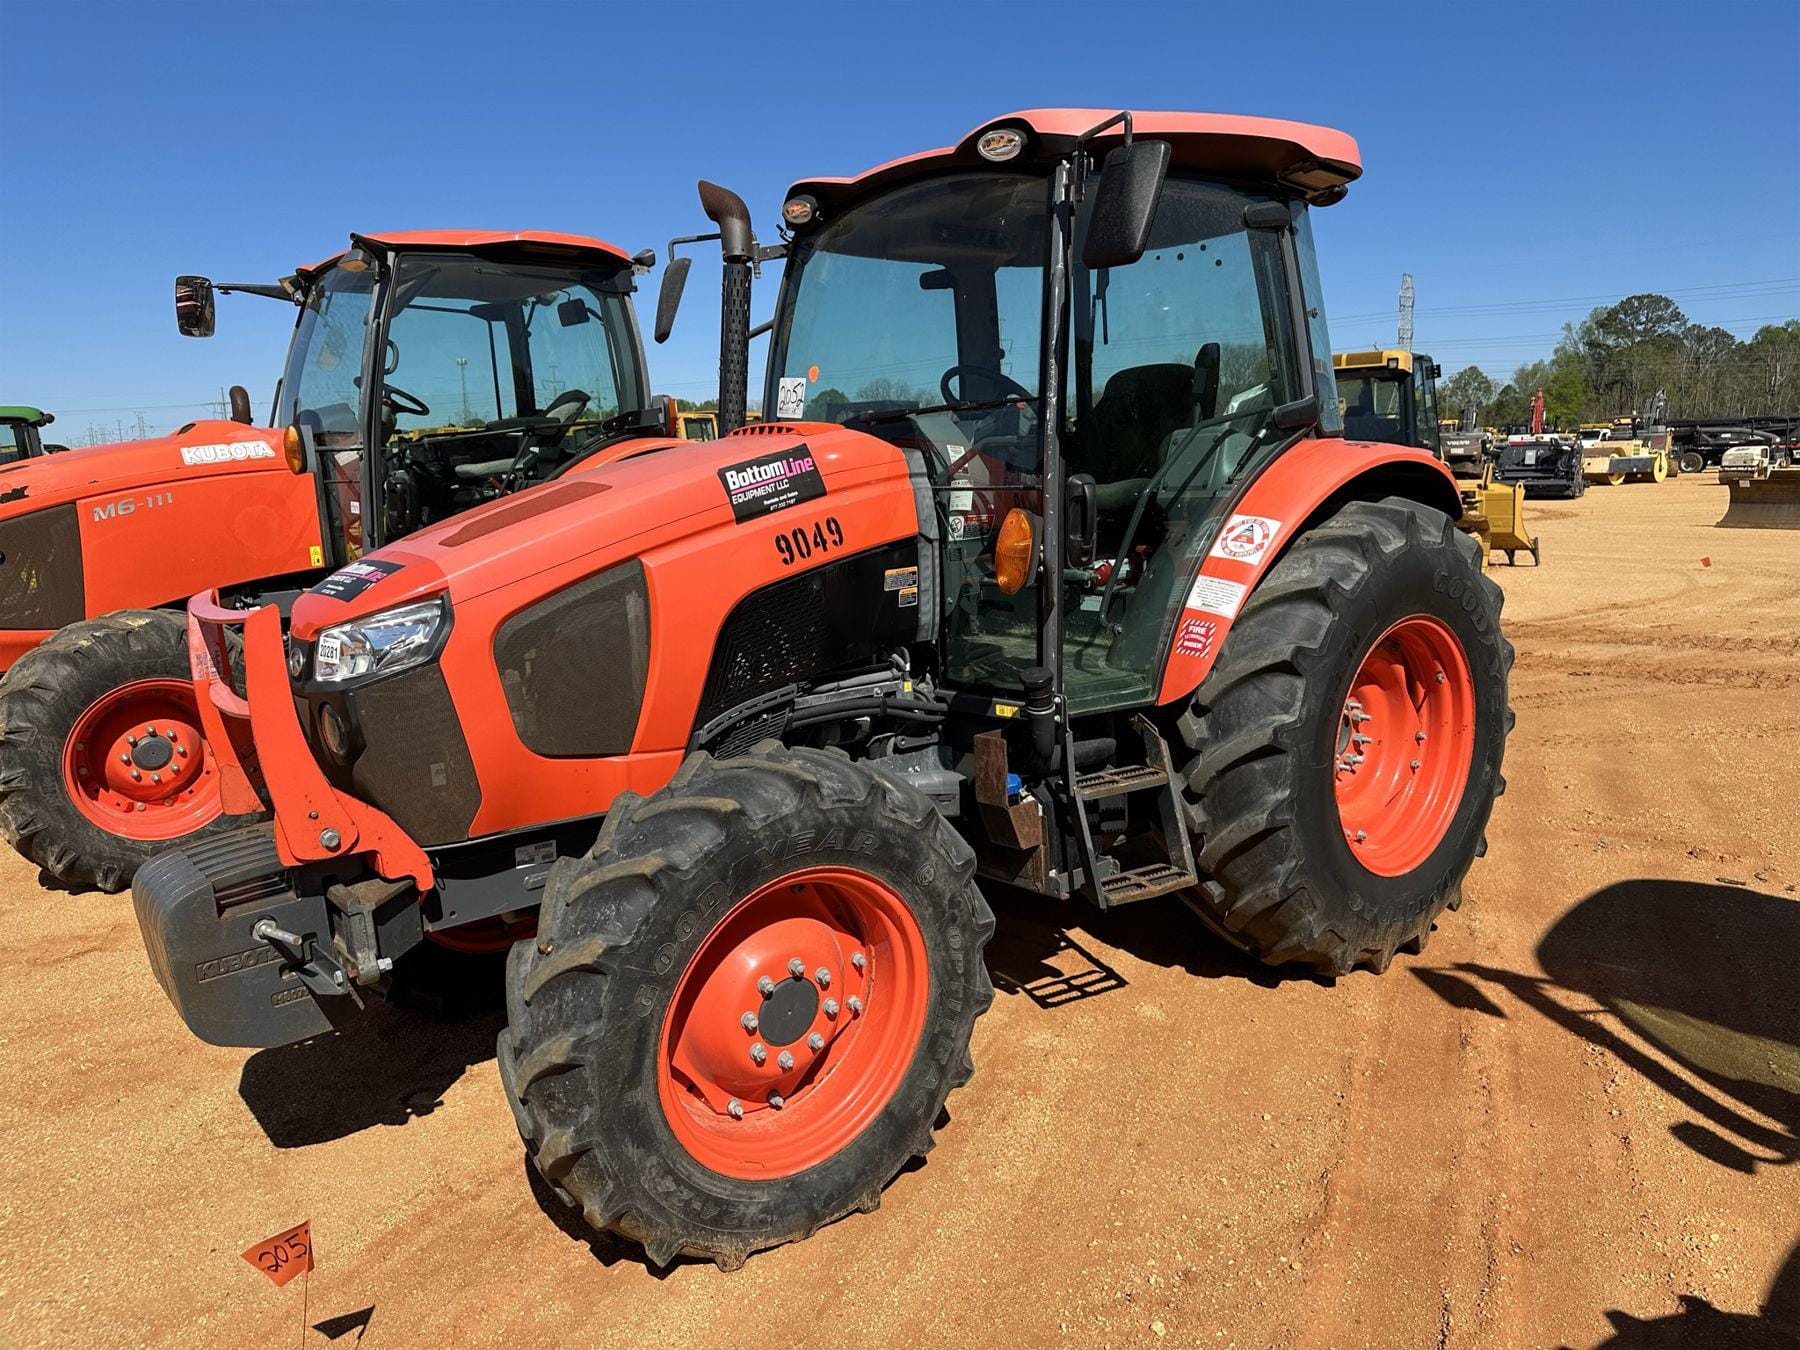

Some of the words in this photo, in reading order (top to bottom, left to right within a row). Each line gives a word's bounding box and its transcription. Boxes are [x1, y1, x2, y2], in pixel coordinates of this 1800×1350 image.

[183, 441, 275, 464] KUBOTA
[732, 484, 775, 505] EQUIPMENT
[776, 479, 790, 491] LLC
[93, 492, 173, 522] M6-111
[775, 517, 844, 565] 9049
[1188, 625, 1208, 635] FIRE
[319, 644, 338, 660] 20281
